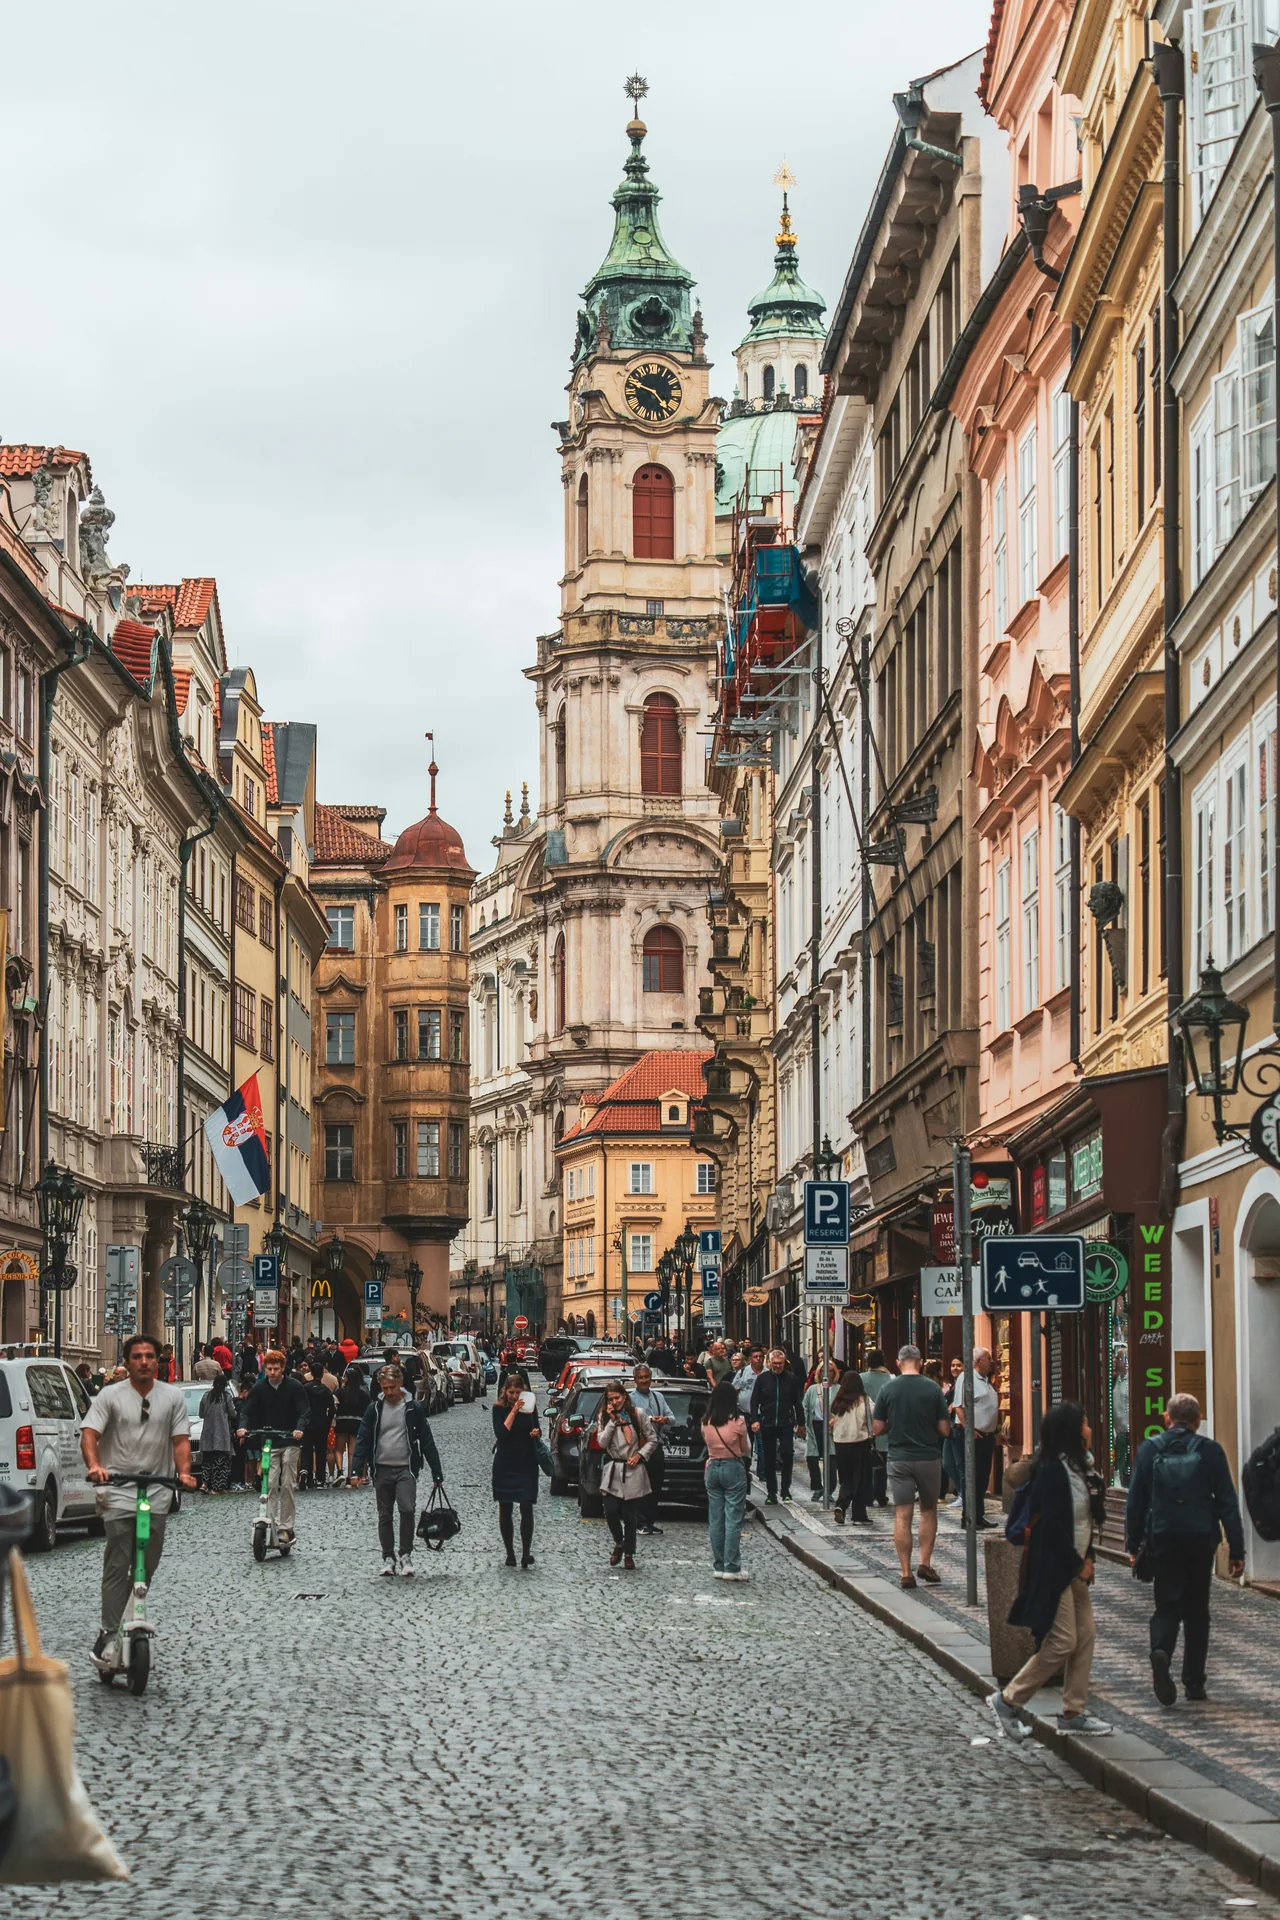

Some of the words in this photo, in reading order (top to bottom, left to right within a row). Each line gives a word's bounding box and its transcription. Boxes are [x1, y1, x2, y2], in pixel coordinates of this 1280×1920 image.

[815, 1190, 839, 1225] P
[809, 1228, 845, 1237] RÉSERVÉ
[970, 1217, 1015, 1237] Pork's
[1100, 1244, 1123, 1262] SHOP
[7, 1251, 37, 1274] COCKTAIL
[259, 1259, 272, 1278] P
[706, 1271, 718, 1288] P
[1139, 1225, 1165, 1330] WEED
[368, 1284, 379, 1298] P
[819, 1295, 843, 1303] P1-0186
[1143, 1367, 1165, 1440] SHO
[671, 1446, 687, 1455] 719
